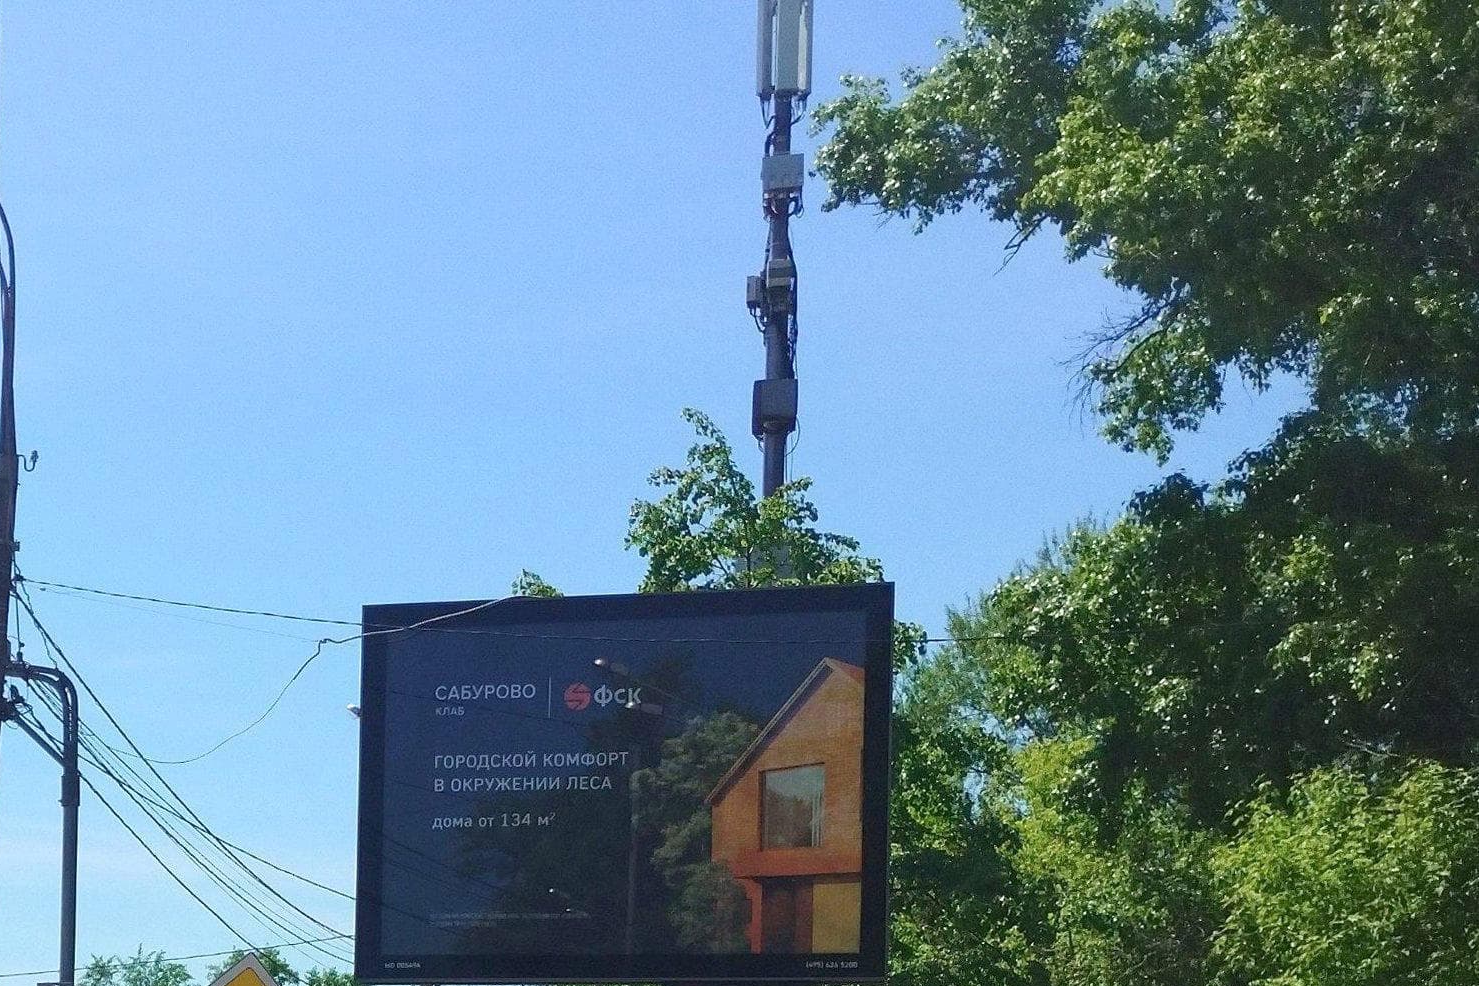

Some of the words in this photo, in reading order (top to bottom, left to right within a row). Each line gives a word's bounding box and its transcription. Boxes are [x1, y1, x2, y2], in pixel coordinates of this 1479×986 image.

[434, 684, 536, 701] САБУРОВО
[593, 684, 642, 707] ФСК
[435, 706, 465, 716] КЛАБ
[434, 750, 536, 771] ГОРОДСКОЙ
[543, 751, 629, 768] КОМФОРТ
[434, 778, 444, 792] В
[450, 776, 560, 792] ОКРУЖЕНИИ
[566, 776, 613, 791] ЛЕСА
[432, 817, 472, 830] дома
[478, 817, 494, 827] от
[501, 813, 531, 828] 134
